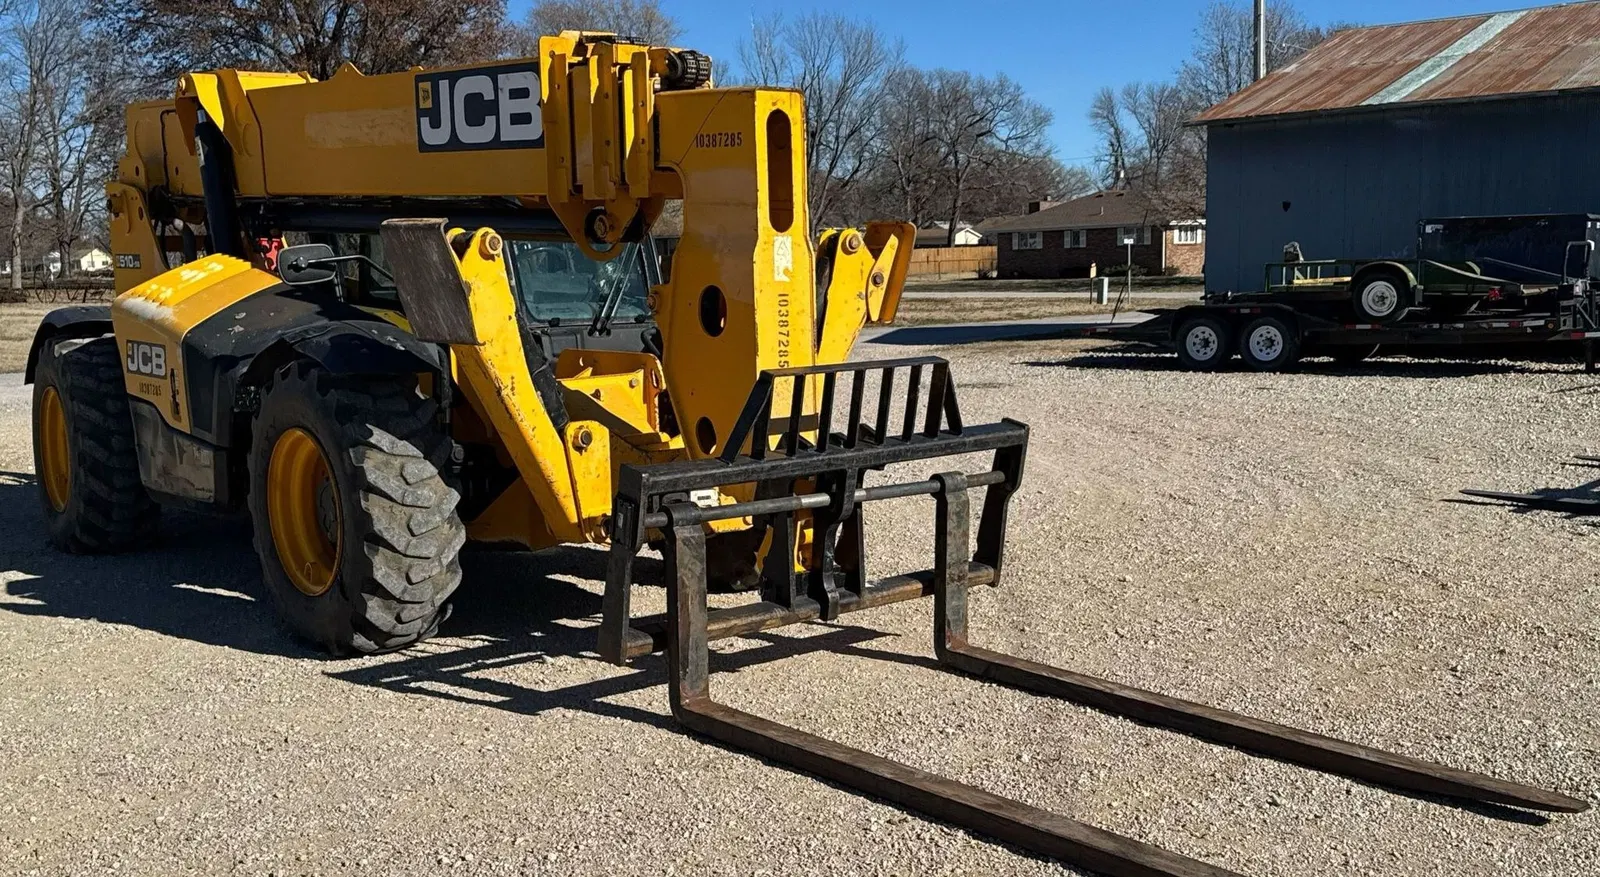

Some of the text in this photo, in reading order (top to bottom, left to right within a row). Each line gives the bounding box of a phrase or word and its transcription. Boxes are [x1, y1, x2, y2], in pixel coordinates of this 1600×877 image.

[420, 71, 543, 146] JCB
[695, 131, 743, 148] 10387285
[777, 293, 790, 368] 10387285
[127, 343, 167, 376] JCB
